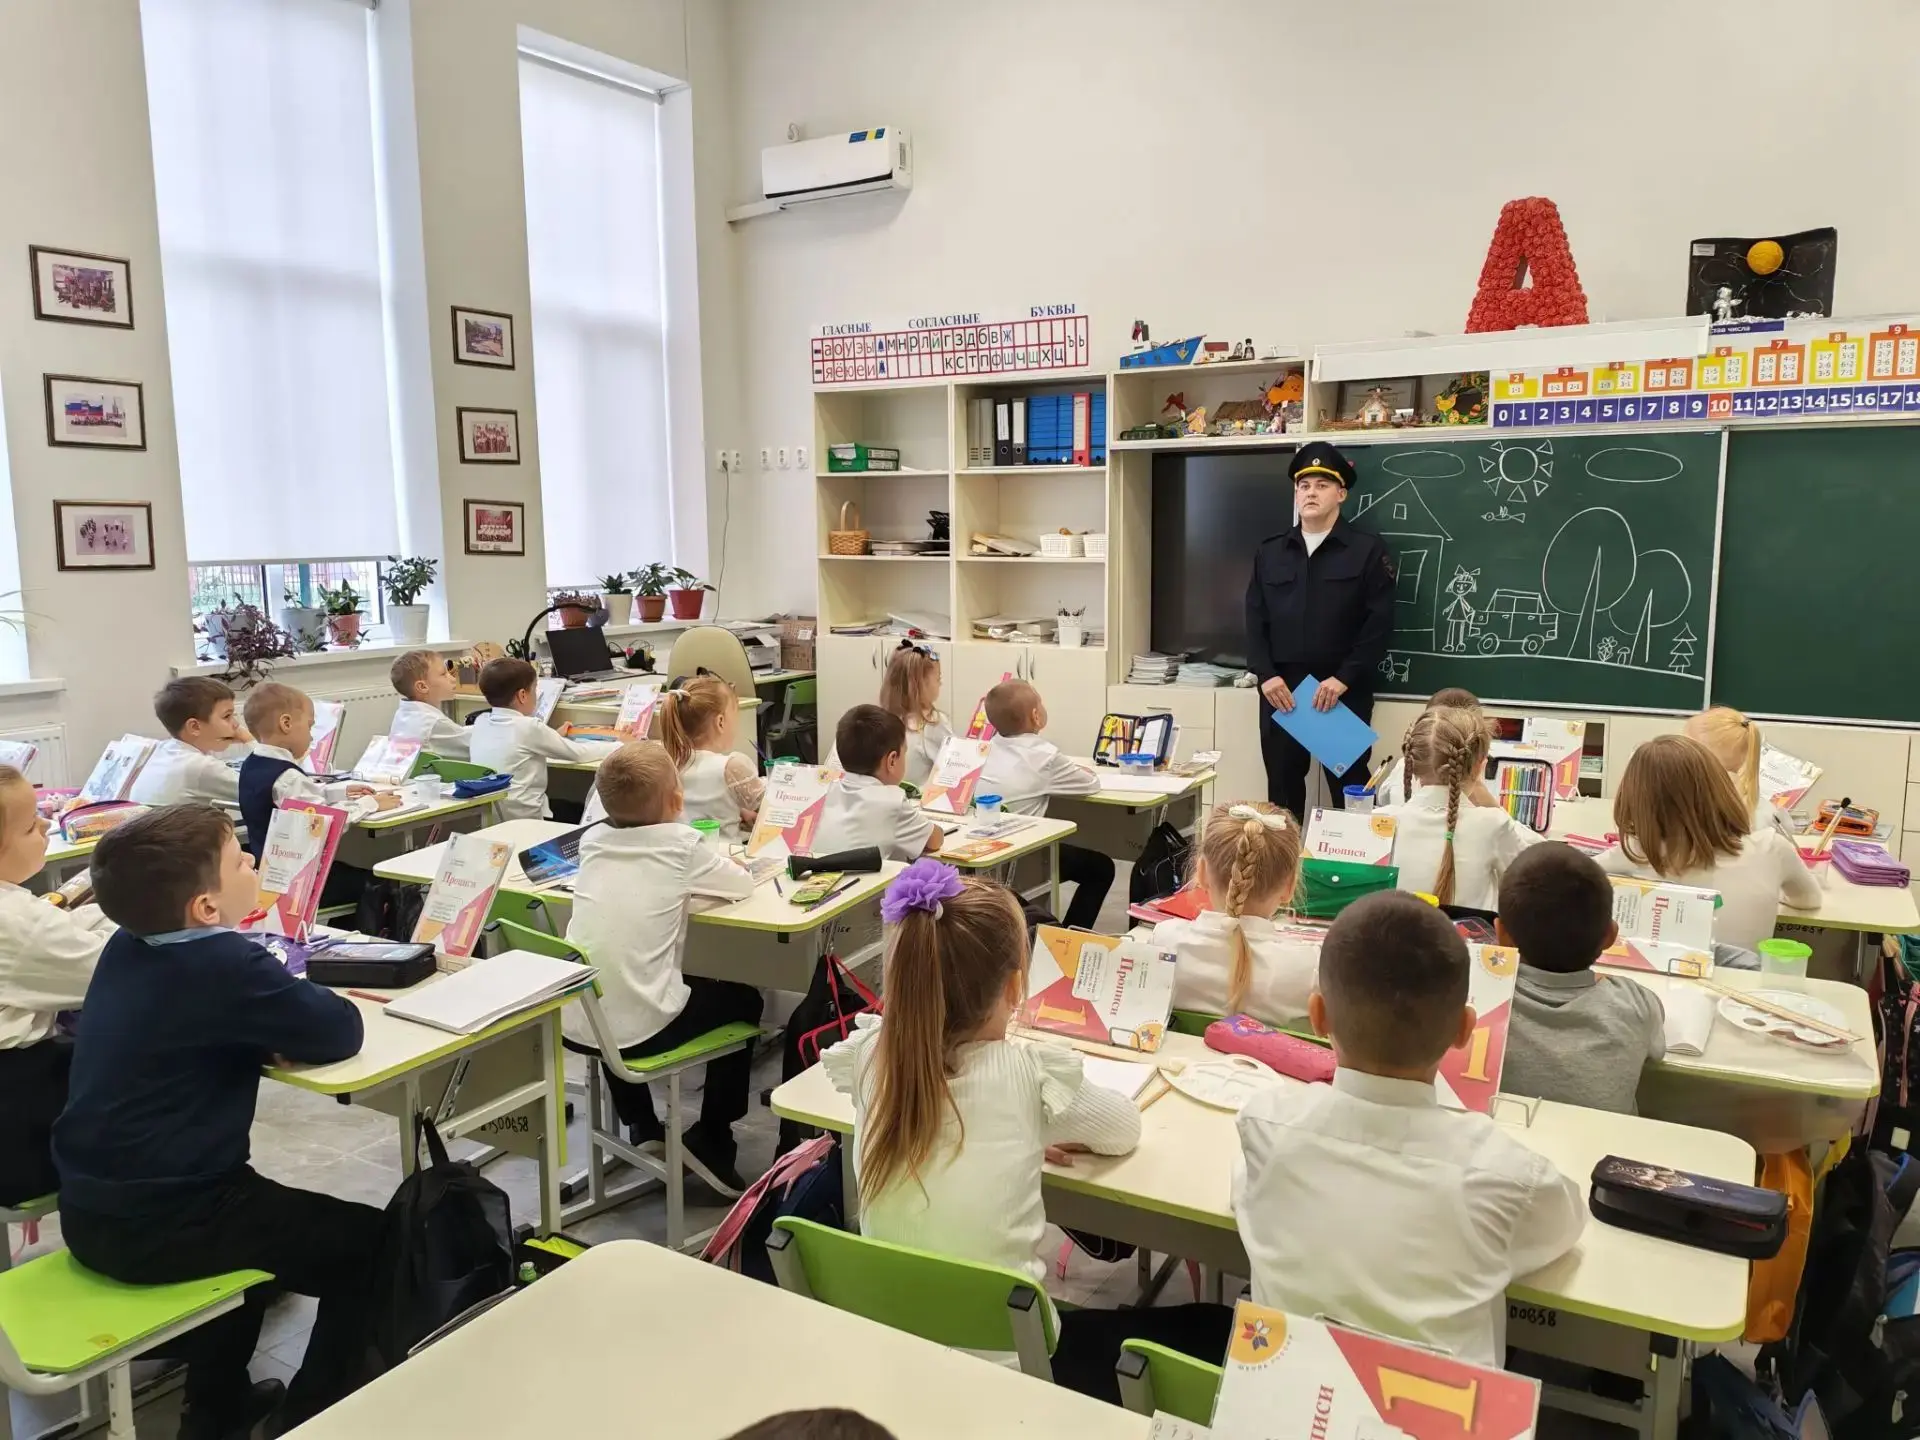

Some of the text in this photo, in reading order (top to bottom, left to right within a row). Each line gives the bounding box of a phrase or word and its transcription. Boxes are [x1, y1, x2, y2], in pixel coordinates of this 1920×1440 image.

[1464, 196, 1590, 334] А
[822, 304, 1076, 336] ГЛАСНЫЕ СОГЛАСНЫЕ БУКВЫ
[1499, 410, 1507, 421] 0
[1519, 409, 1527, 420] 1
[1539, 408, 1548, 420] 2
[1560, 407, 1570, 418] 3
[1581, 406, 1591, 417] 4
[1603, 405, 1613, 416] 5
[1625, 404, 1634, 415] 6
[1647, 403, 1657, 415] 7
[1669, 401, 1679, 414] 8
[1692, 400, 1702, 413] 9
[1710, 400, 1730, 412] 10
[1734, 399, 1753, 411] 11
[1757, 397, 1777, 410] 12
[1781, 396, 1801, 409] 13
[1805, 395, 1826, 407] 14
[1830, 394, 1851, 406] 15
[1855, 393, 1876, 405] 16
[1880, 392, 1902, 405] 17
[955, 778, 974, 804] 1
[793, 812, 814, 847] 1
[1317, 841, 1366, 858] Прописи
[286, 875, 306, 916] 1
[451, 906, 477, 947] 1
[1110, 956, 1134, 1017] Прописи
[1035, 998, 1087, 1026] 1
[1460, 1026, 1490, 1082] 1
[1376, 1365, 1479, 1433] 1
